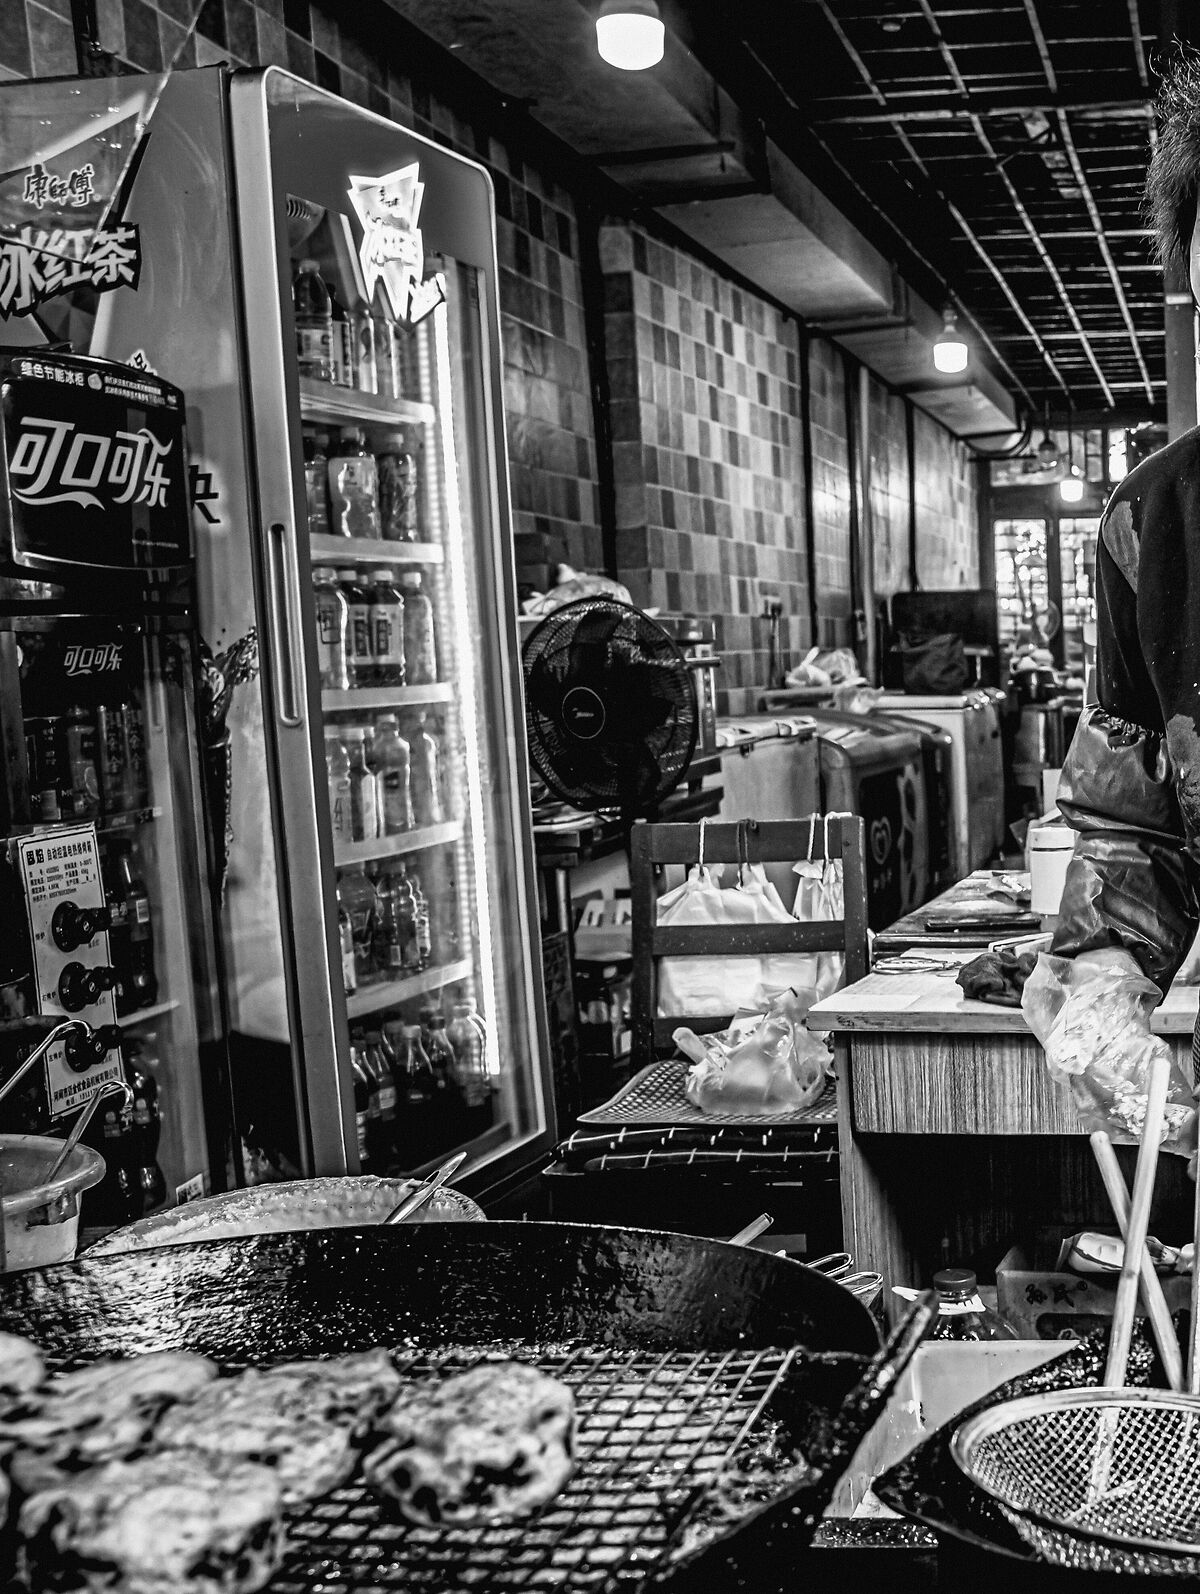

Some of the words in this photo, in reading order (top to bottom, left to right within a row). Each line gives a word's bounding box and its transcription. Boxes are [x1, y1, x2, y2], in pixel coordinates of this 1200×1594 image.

[0, 226, 137, 311] 冰红茶
[9, 416, 174, 509] 可口可乐
[64, 643, 123, 676] 可口可乐
